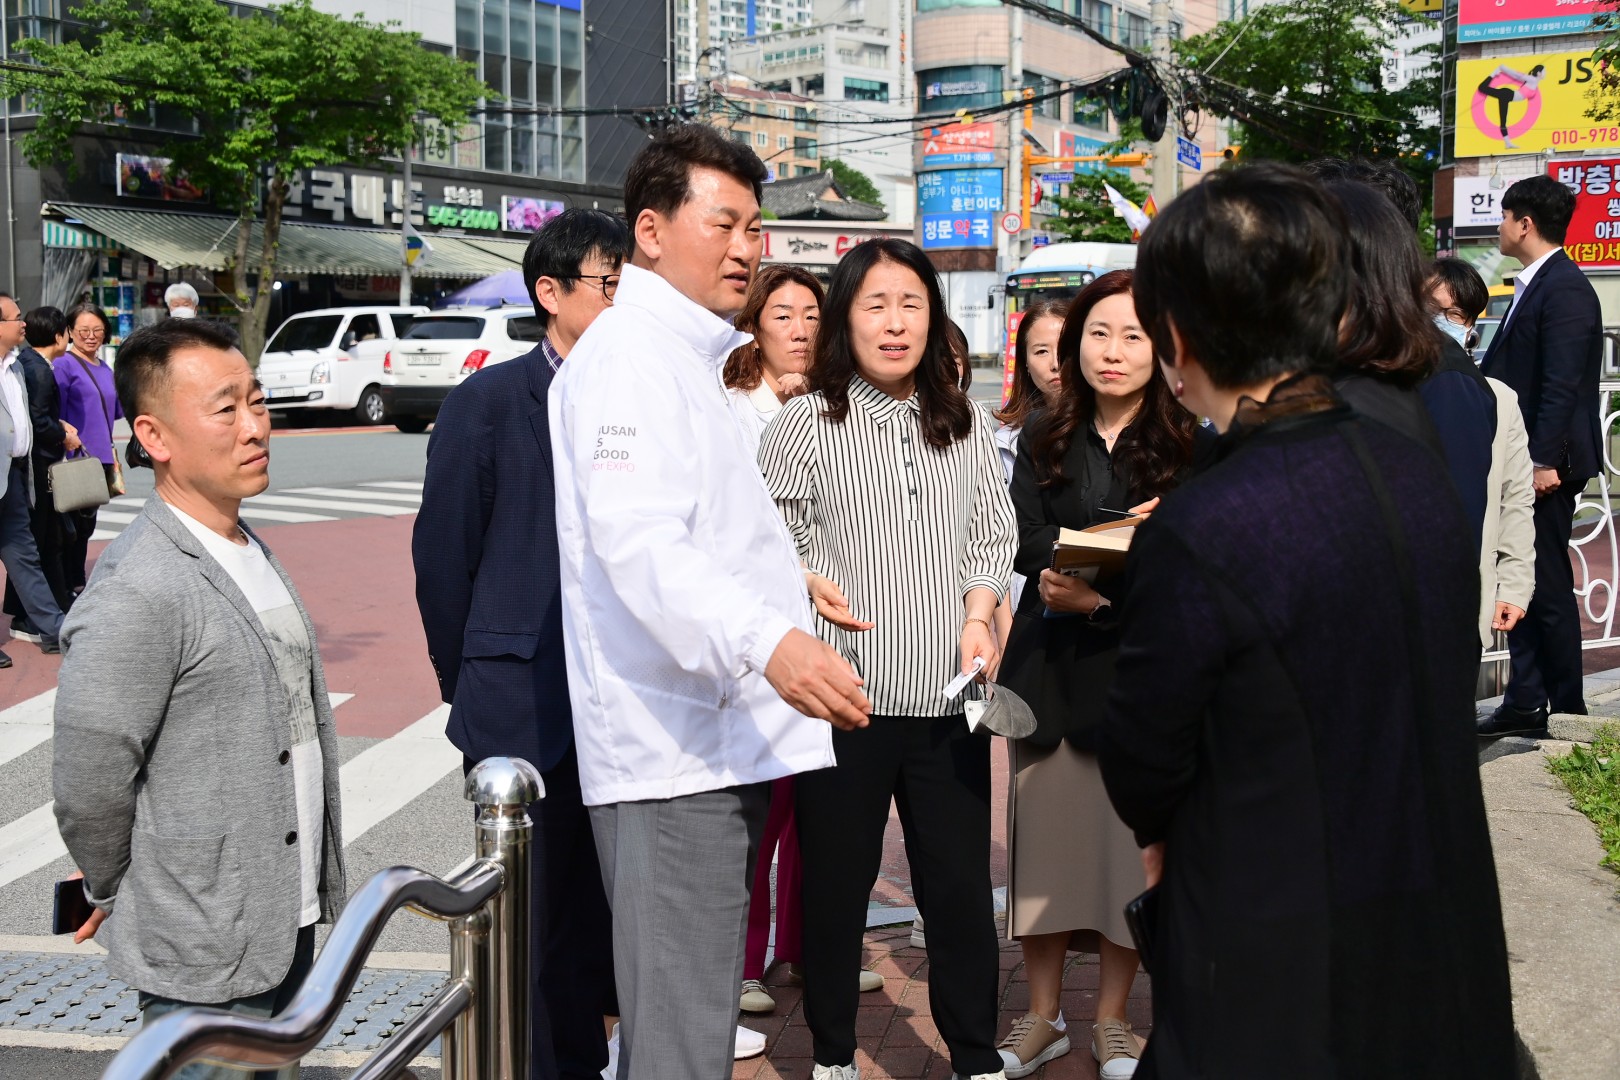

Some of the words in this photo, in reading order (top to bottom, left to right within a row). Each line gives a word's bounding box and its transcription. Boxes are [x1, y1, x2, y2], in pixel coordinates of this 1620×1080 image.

[1558, 57, 1593, 84] JS
[1551, 127, 1619, 145] 010-978
[1558, 164, 1620, 195] 방충
[950, 185, 984, 196] 아니고
[428, 204, 499, 231] 545-2000
[924, 219, 990, 240] 정문약국
[598, 425, 636, 437] USAN
[593, 449, 629, 460] GOOD
[606, 461, 635, 472] EXPO
